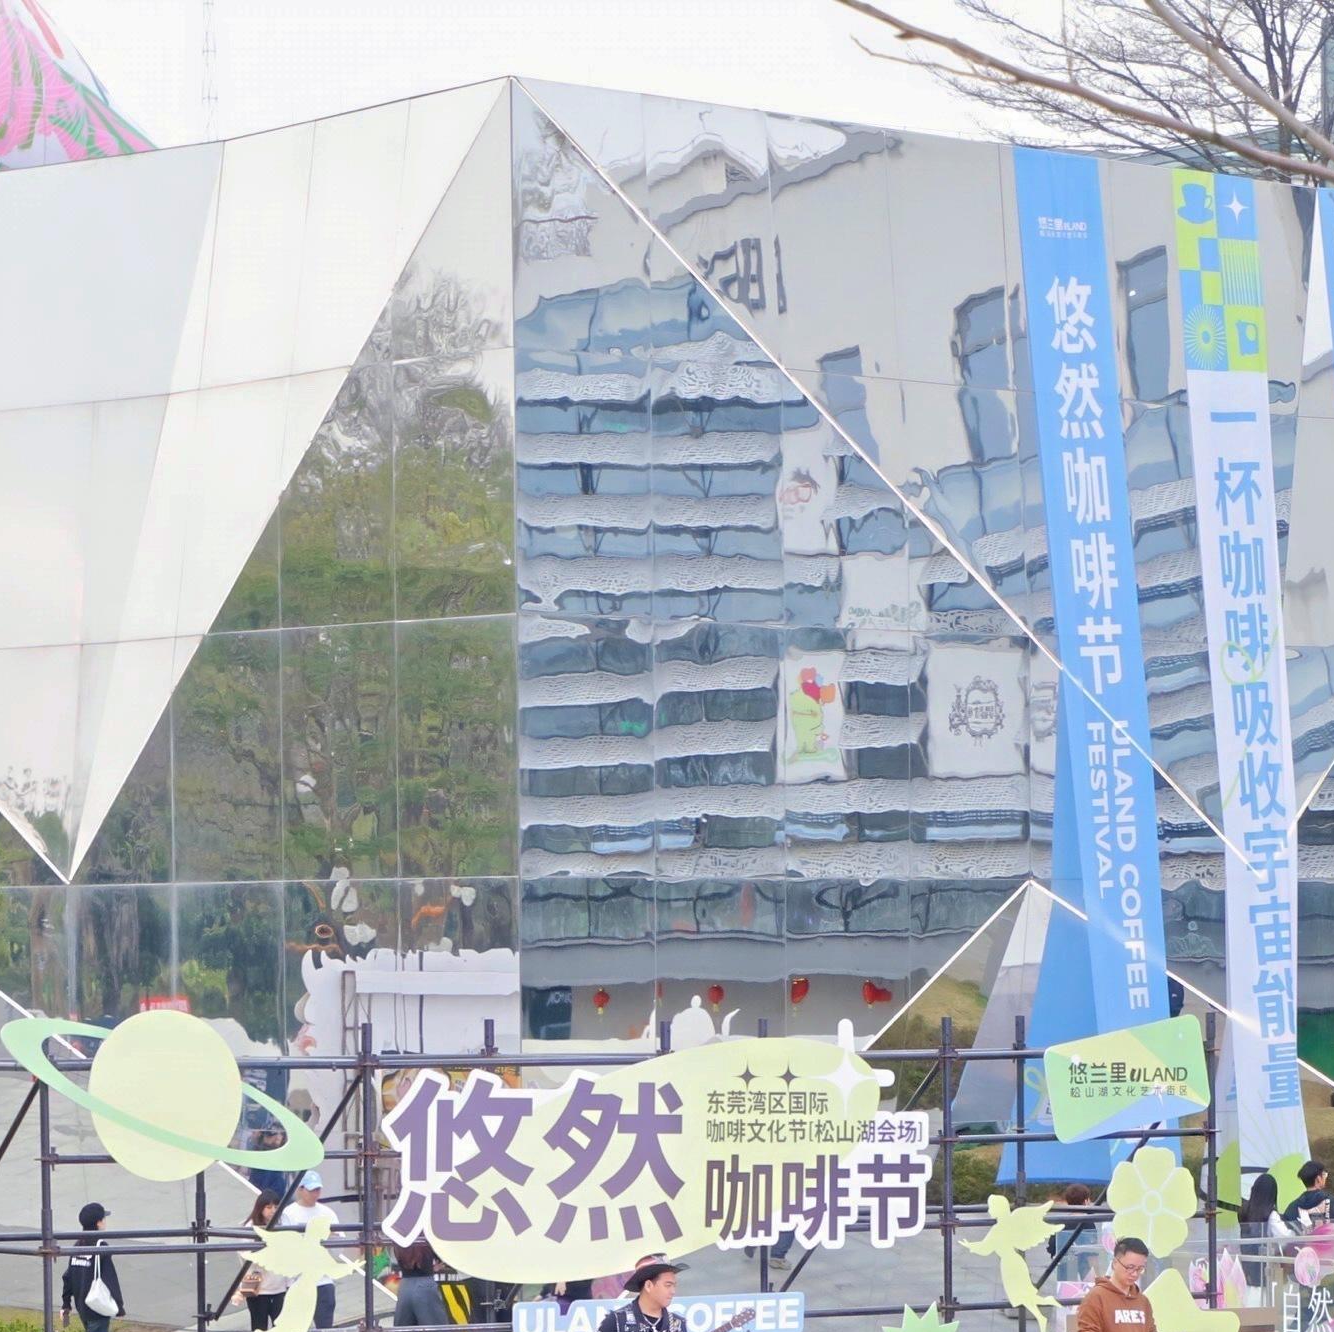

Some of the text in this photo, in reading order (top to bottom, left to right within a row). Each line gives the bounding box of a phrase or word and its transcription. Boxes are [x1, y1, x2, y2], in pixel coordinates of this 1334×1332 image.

[1044, 275, 1124, 696] 悠然咖啡节
[1086, 721, 1115, 900] FESTIVAL
[1209, 408, 1300, 1110] 一杯咖啡吸收宇宙能量
[1110, 719, 1151, 1010] ULAND COFFEE
[705, 1089, 829, 1115] 东莞湾区国际
[1068, 1061, 1127, 1084] 悠兰里
[390, 1077, 685, 1243] 悠然
[704, 1153, 926, 1241] 咖啡节
